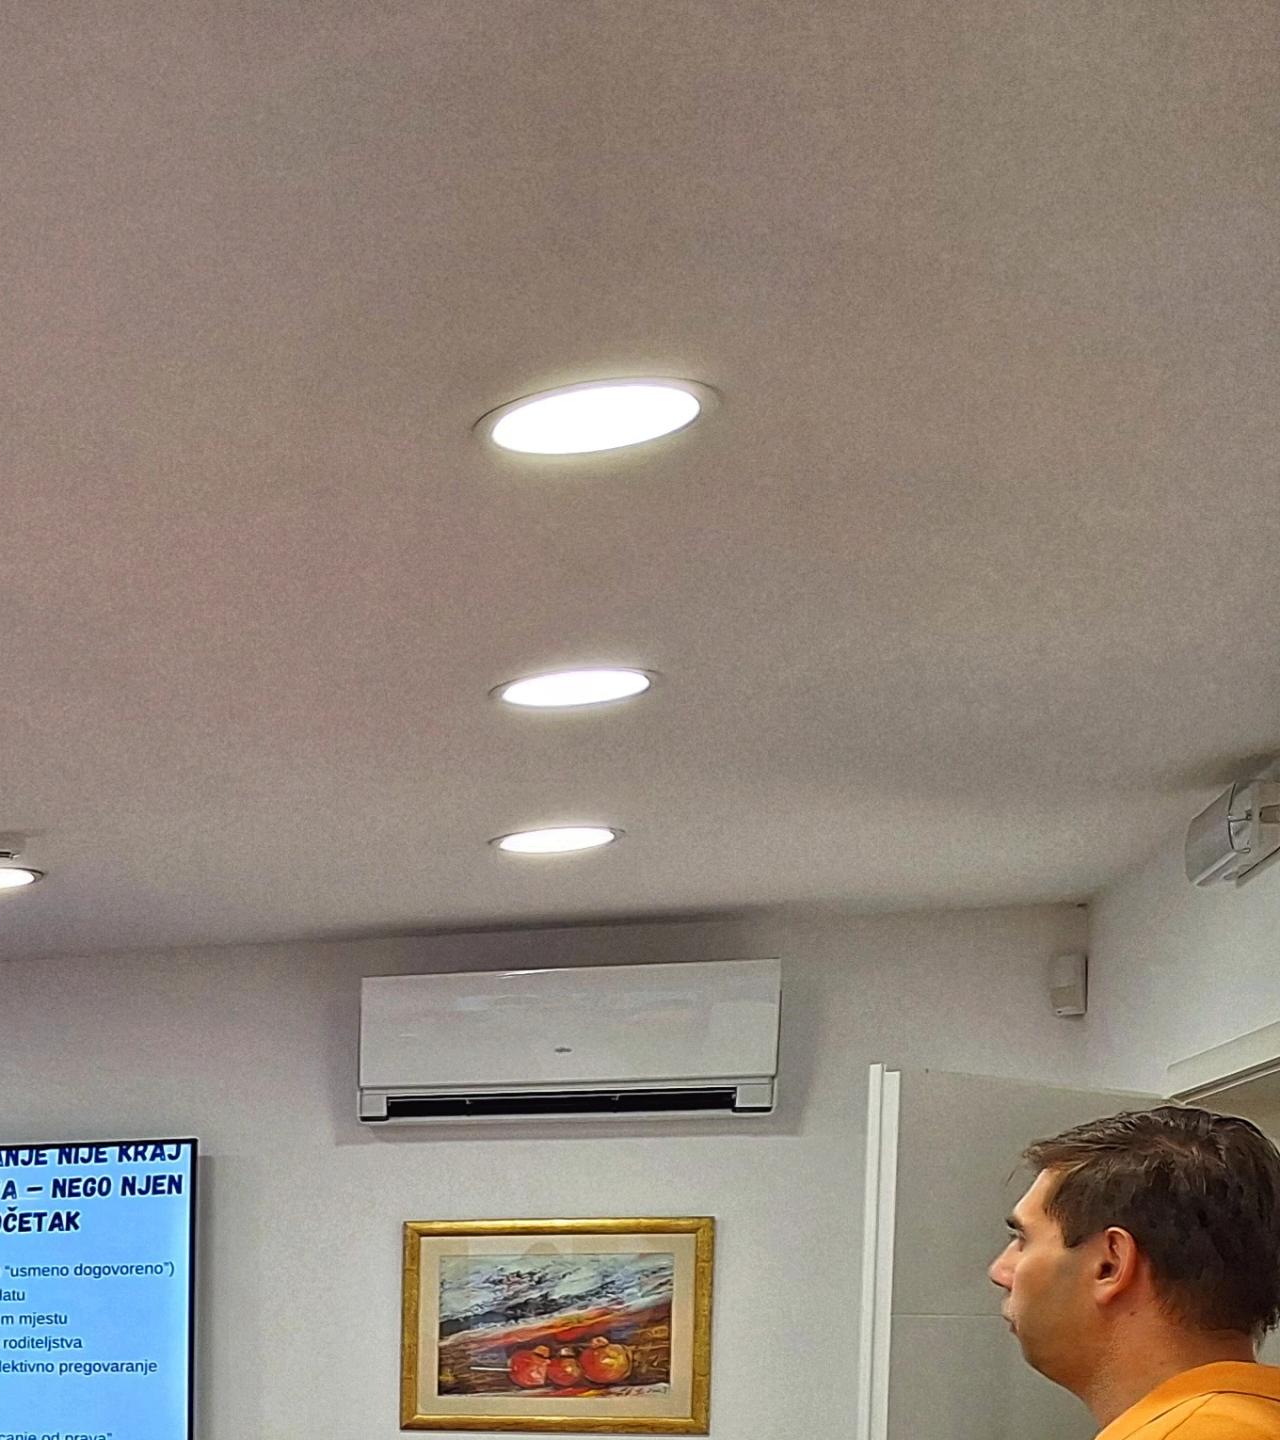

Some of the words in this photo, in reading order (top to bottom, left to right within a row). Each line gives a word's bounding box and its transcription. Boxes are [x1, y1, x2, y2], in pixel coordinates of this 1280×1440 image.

[57, 1147, 108, 1165] NIJE
[117, 1144, 182, 1163] KRAJ
[51, 1176, 112, 1199] NEGO
[121, 1174, 183, 1196] NJEN
[18, 1312, 68, 1328] mjestu
[3, 1335, 83, 1351] roditeljstva
[58, 1359, 158, 1375] pregovaranje
